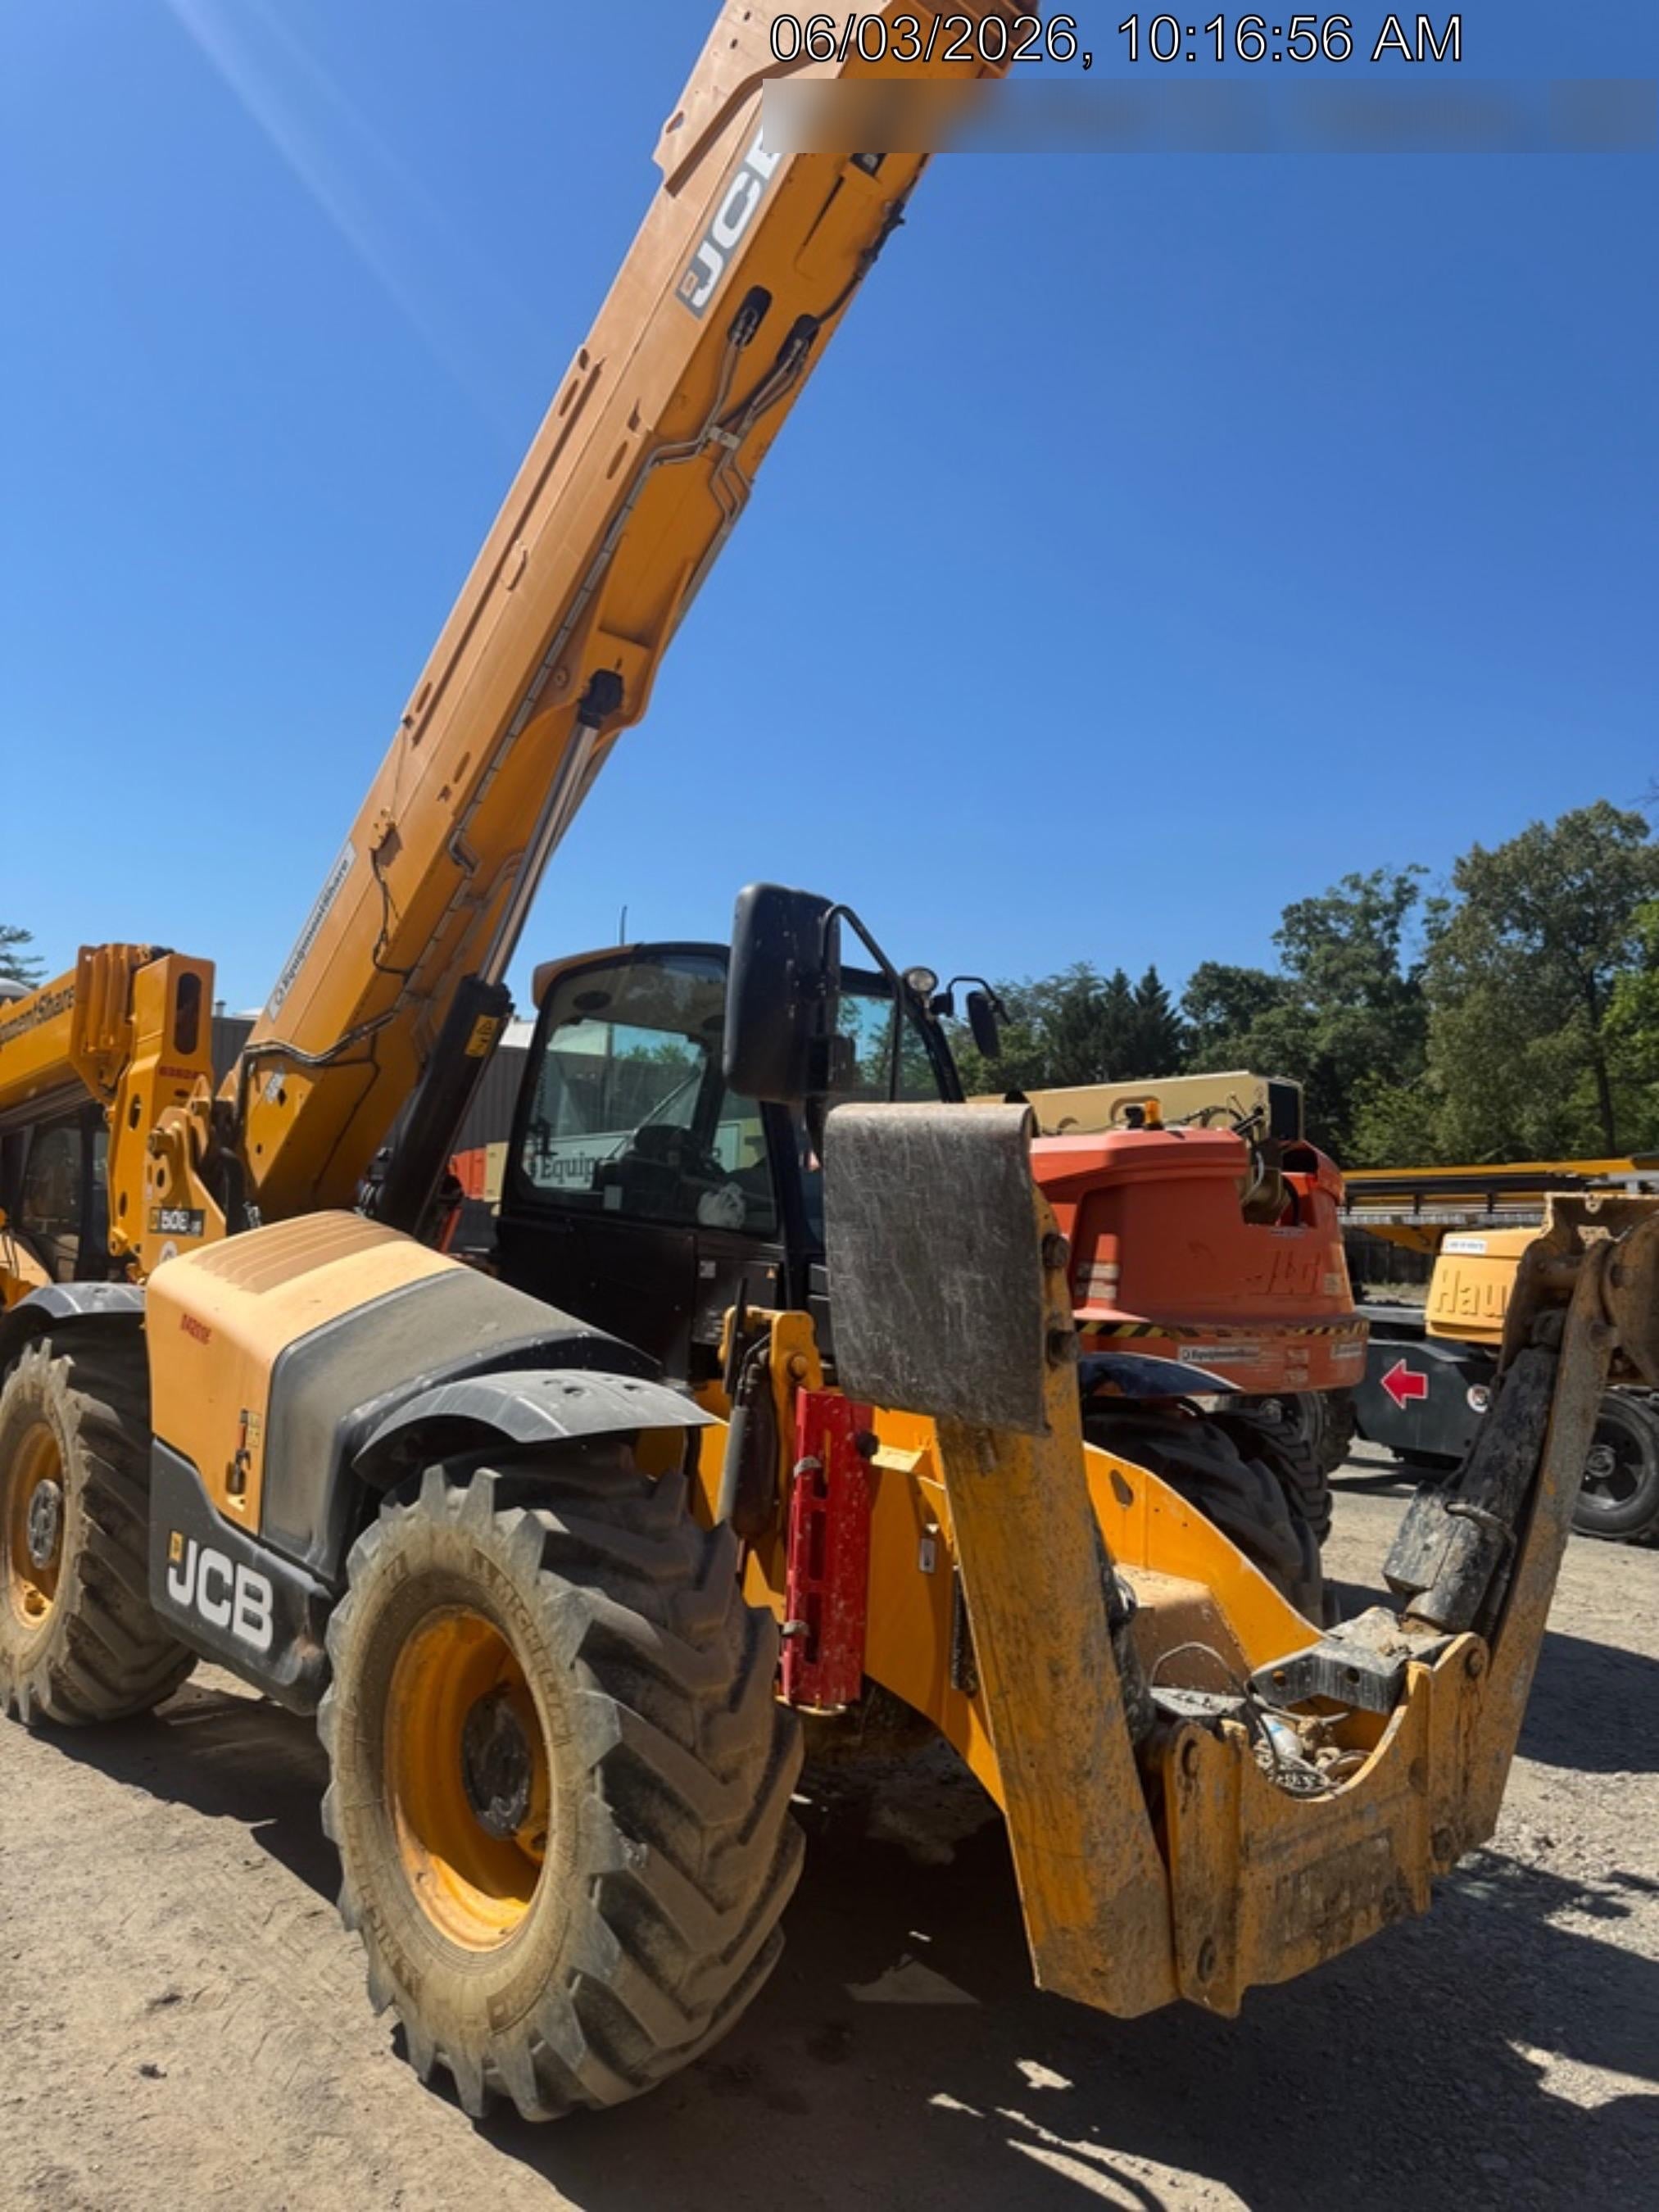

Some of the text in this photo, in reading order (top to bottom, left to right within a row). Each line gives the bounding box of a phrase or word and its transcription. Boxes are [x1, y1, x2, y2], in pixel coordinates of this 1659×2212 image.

[541, 1152, 598, 1185] Equip
[1435, 1267, 1509, 1320] Hau
[168, 1539, 274, 1652] JCB
